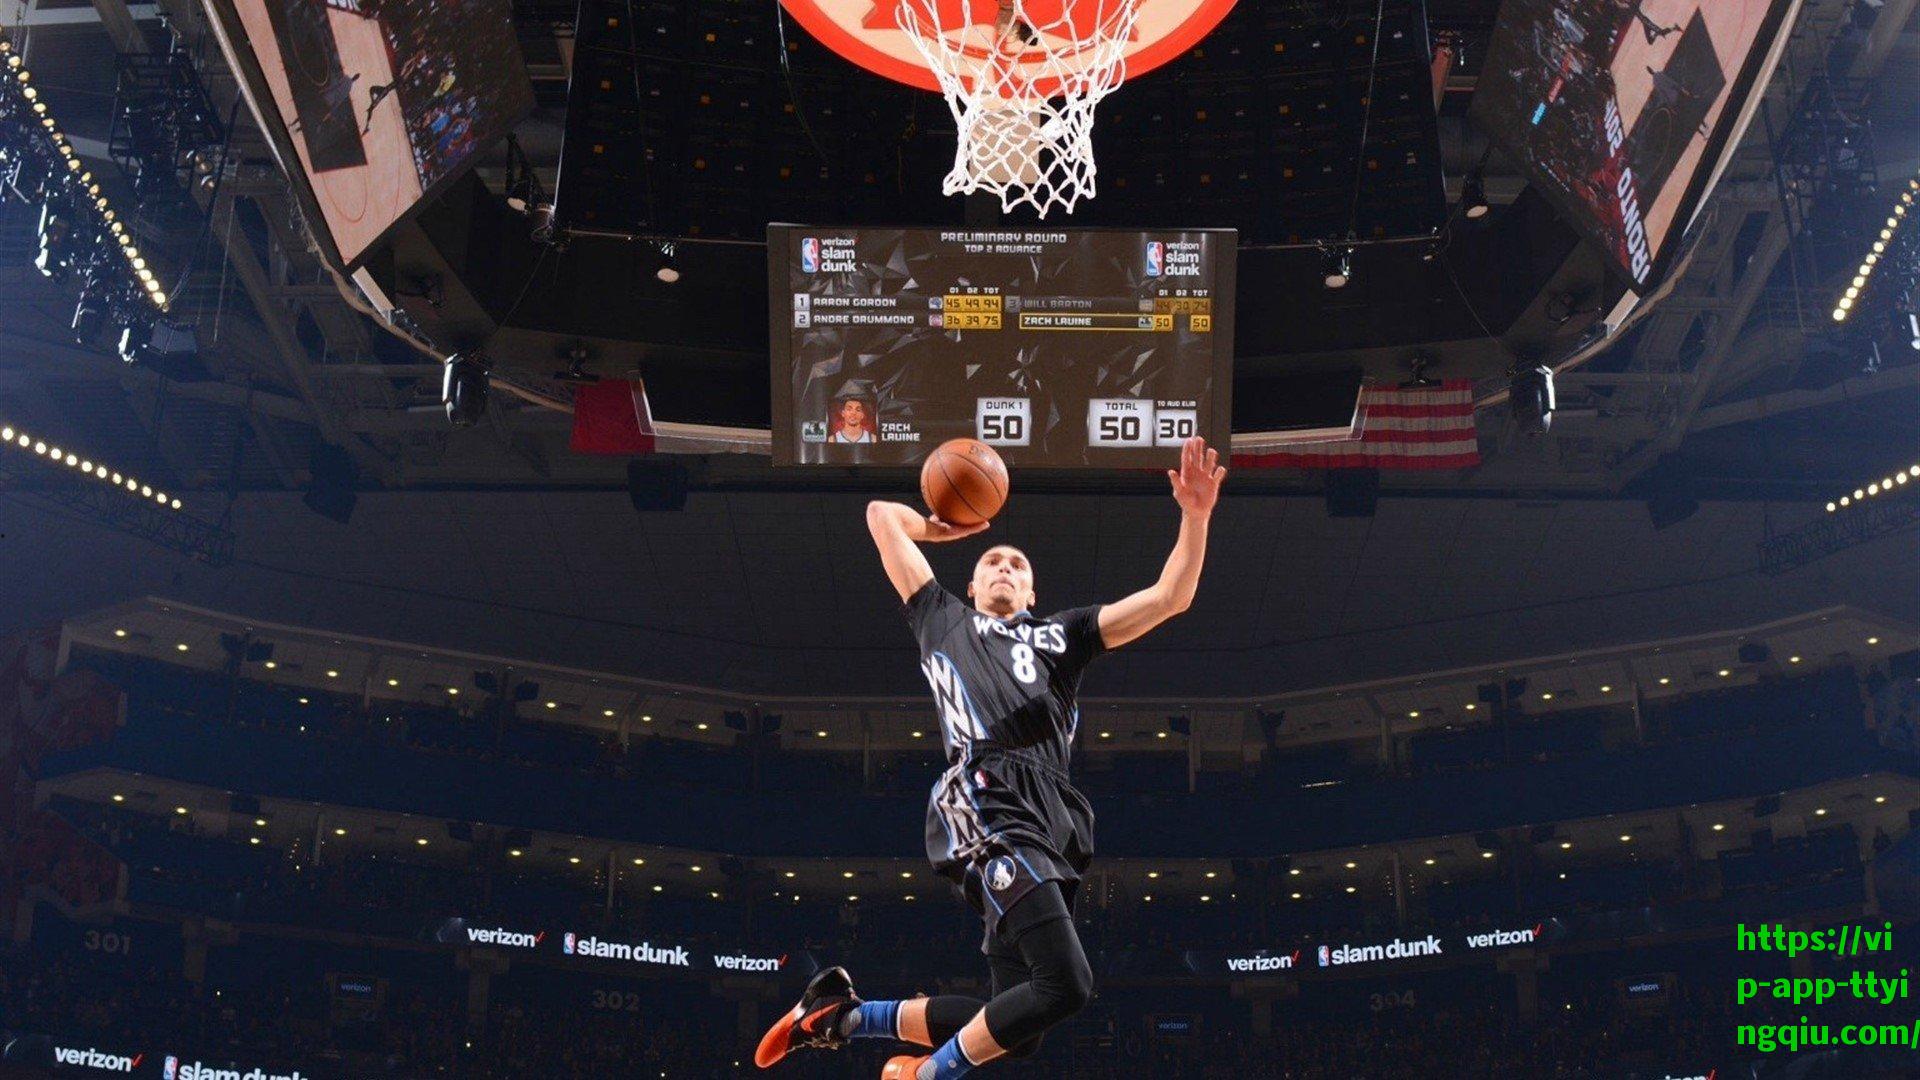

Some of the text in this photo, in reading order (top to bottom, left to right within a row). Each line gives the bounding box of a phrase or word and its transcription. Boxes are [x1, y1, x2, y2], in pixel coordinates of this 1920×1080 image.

[1617, 167, 1651, 284] RONTO
[821, 238, 854, 246] verizon
[940, 232, 1067, 243] PRELIMINARY ROUND
[965, 245, 984, 253] TOP
[986, 245, 993, 253] 2
[1166, 242, 1200, 250] verizon
[821, 247, 856, 260] slam
[1165, 250, 1199, 264] slam
[821, 260, 857, 272] dunk
[1165, 263, 1200, 276] dunk
[813, 298, 850, 307] AARON
[853, 298, 897, 307] GORDON
[946, 299, 960, 308] 45
[965, 299, 980, 308] 49
[984, 299, 999, 308] 94
[798, 314, 806, 324] 2
[813, 315, 850, 324] ANDRE
[853, 315, 915, 324] DRUMMOND
[966, 316, 980, 325] 39
[984, 316, 999, 325] 75
[1024, 316, 1052, 325] ZACH
[1156, 318, 1170, 327] 50
[1192, 318, 1208, 328] 50
[986, 401, 1015, 410] DUNK
[1105, 402, 1138, 411] TOTAL
[881, 423, 911, 432] ZACH
[982, 415, 1023, 440] 50
[1100, 416, 1140, 441] 50
[1159, 418, 1193, 439] 30
[1011, 643, 1037, 683] 8
[467, 927, 535, 948] verizon
[1466, 929, 1534, 949] verizon
[714, 954, 779, 971] verizon
[1227, 951, 1292, 972] verizon
[55, 1047, 131, 1072] verizon
